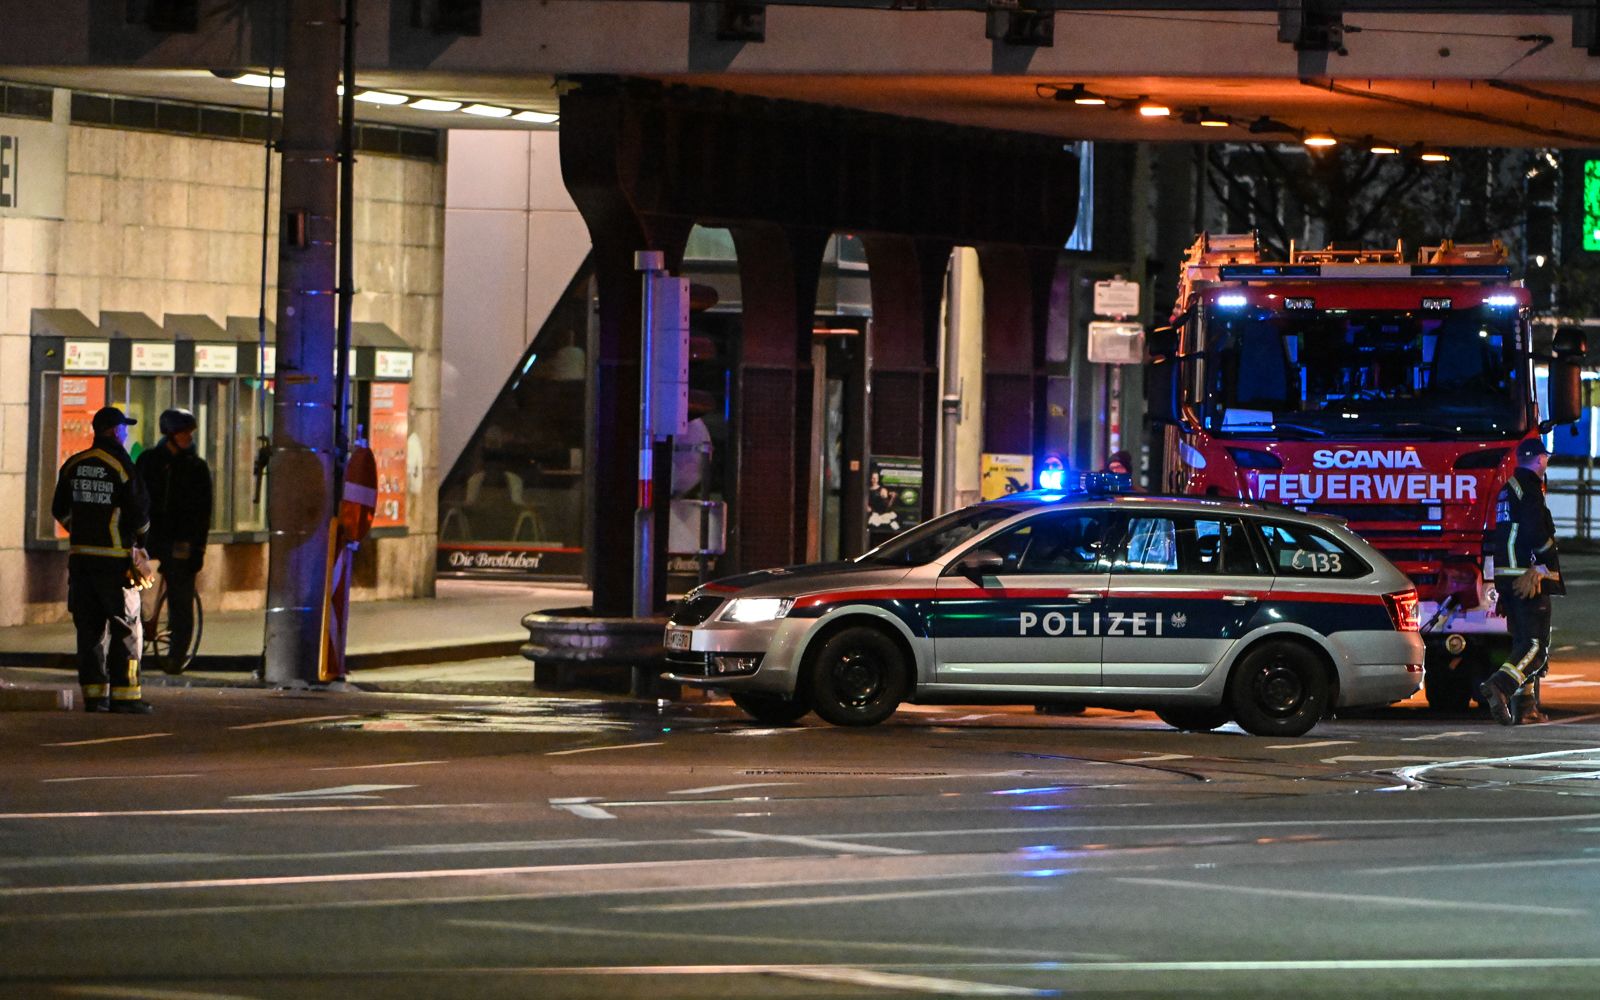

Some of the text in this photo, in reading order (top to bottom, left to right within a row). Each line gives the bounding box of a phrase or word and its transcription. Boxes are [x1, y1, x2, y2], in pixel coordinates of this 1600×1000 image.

[1312, 449, 1422, 469] SCANIA
[71, 479, 113, 493] EERWEHR
[1257, 474, 1478, 499] FEUERWEHR
[449, 551, 473, 567] Die
[1307, 553, 1342, 573] 133
[1019, 611, 1163, 636] POLIZEI
